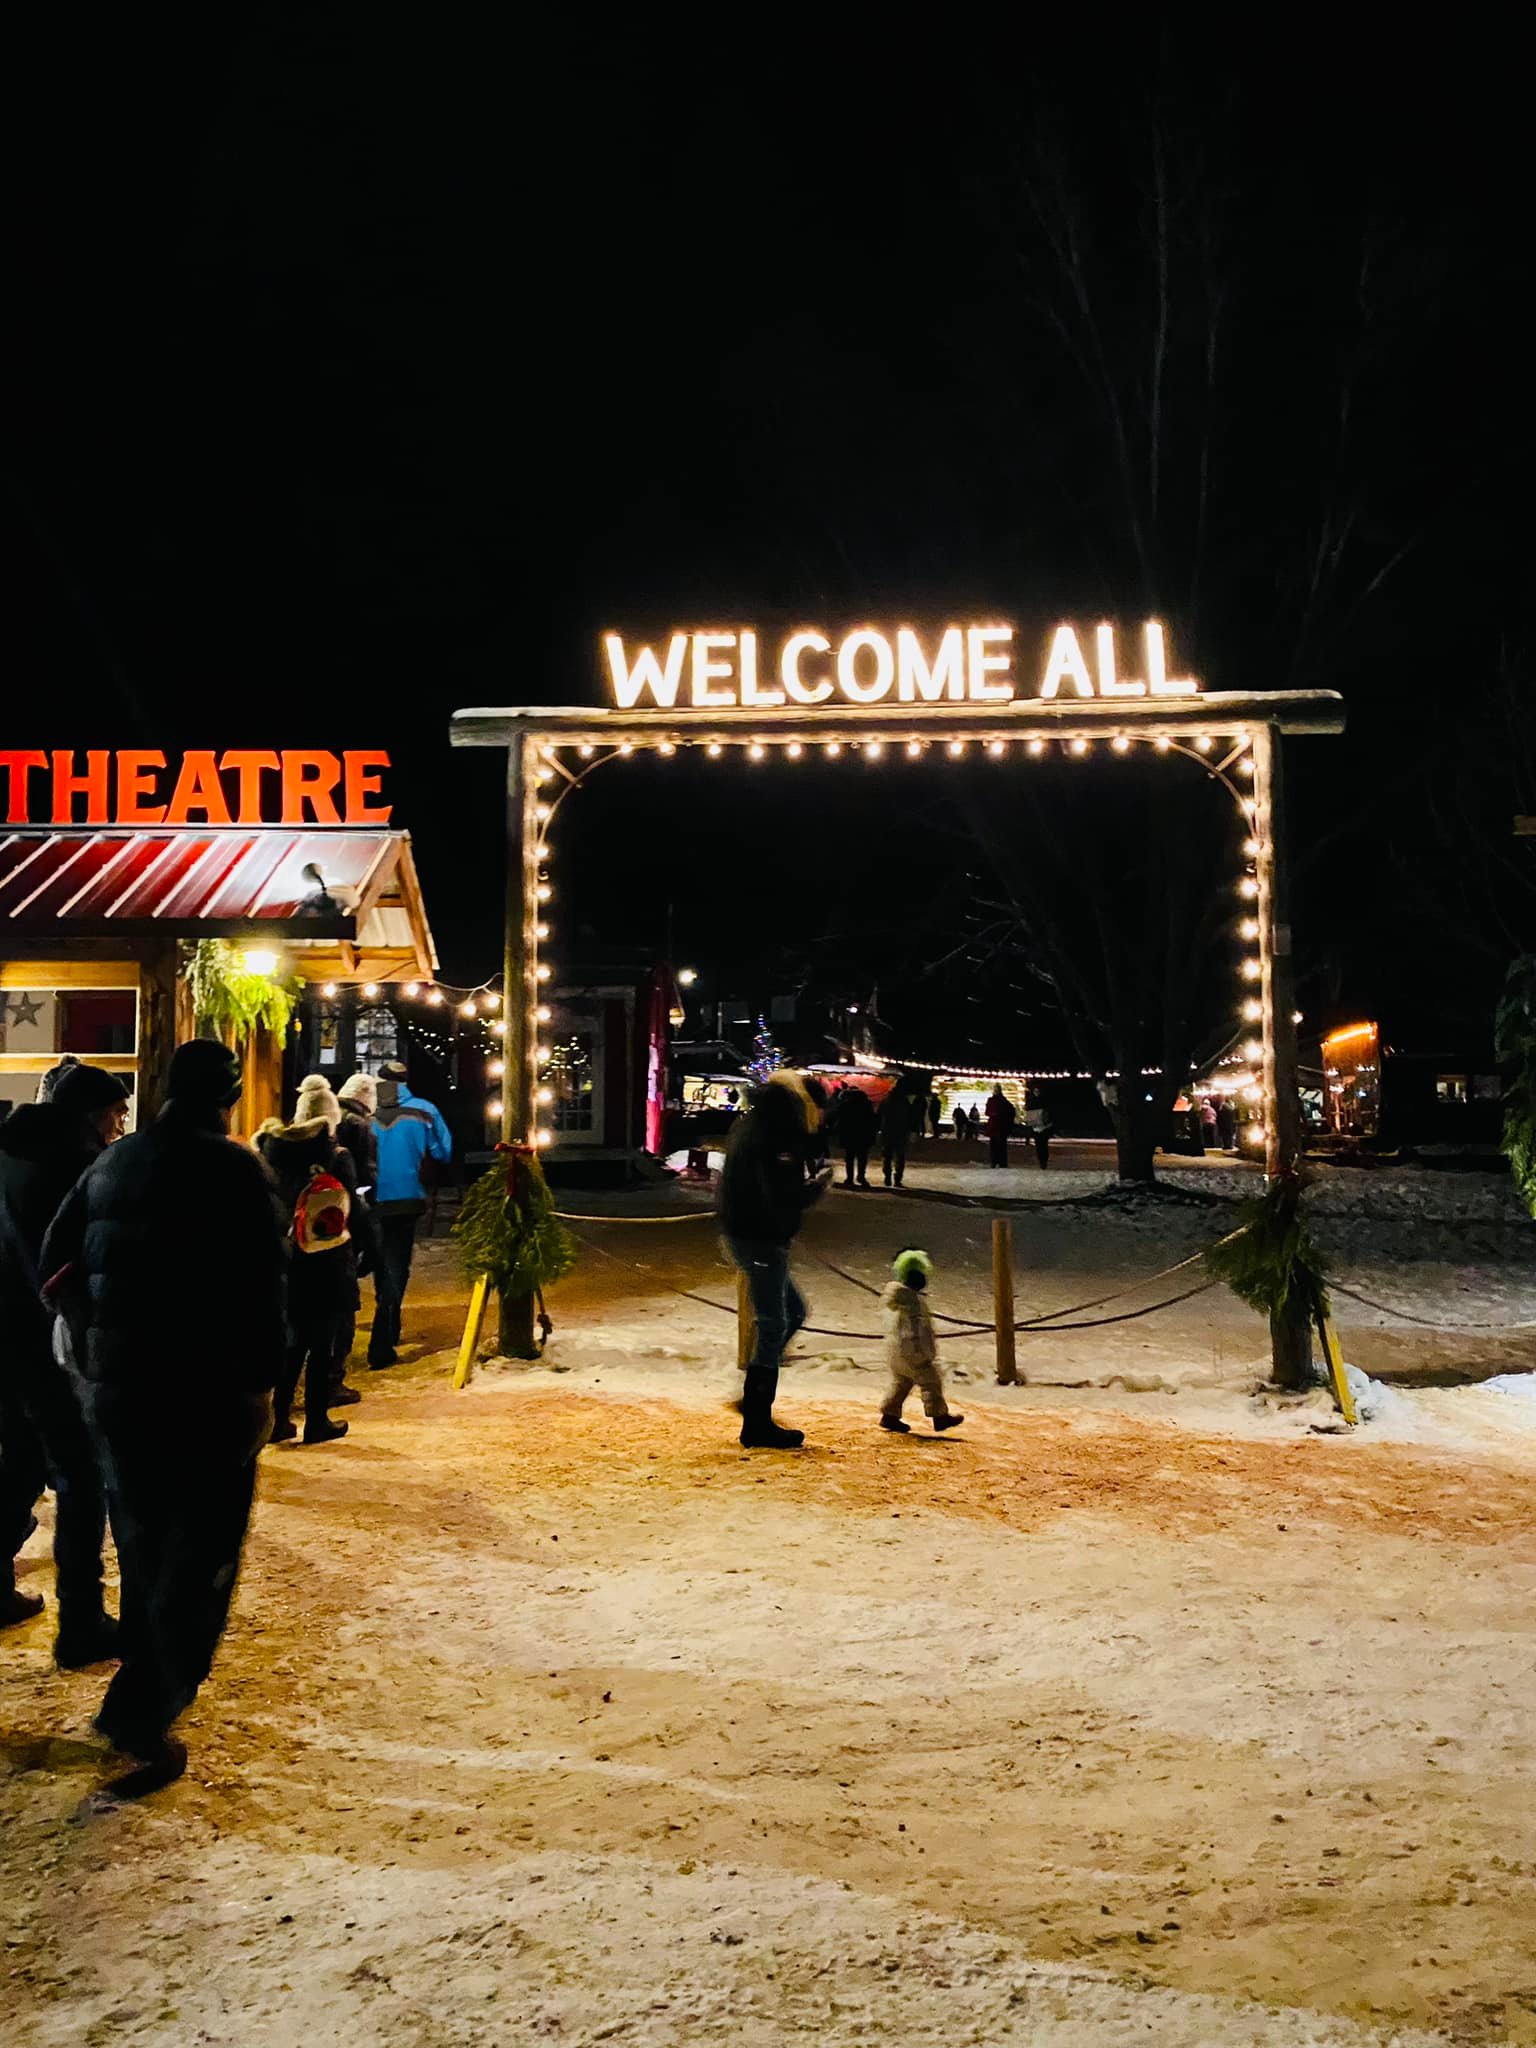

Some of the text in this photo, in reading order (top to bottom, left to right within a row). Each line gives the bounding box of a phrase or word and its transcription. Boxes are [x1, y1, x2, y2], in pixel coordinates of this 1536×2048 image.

[605, 622, 1197, 707] WELCOME ALL
[0, 750, 392, 825] THEATRE
